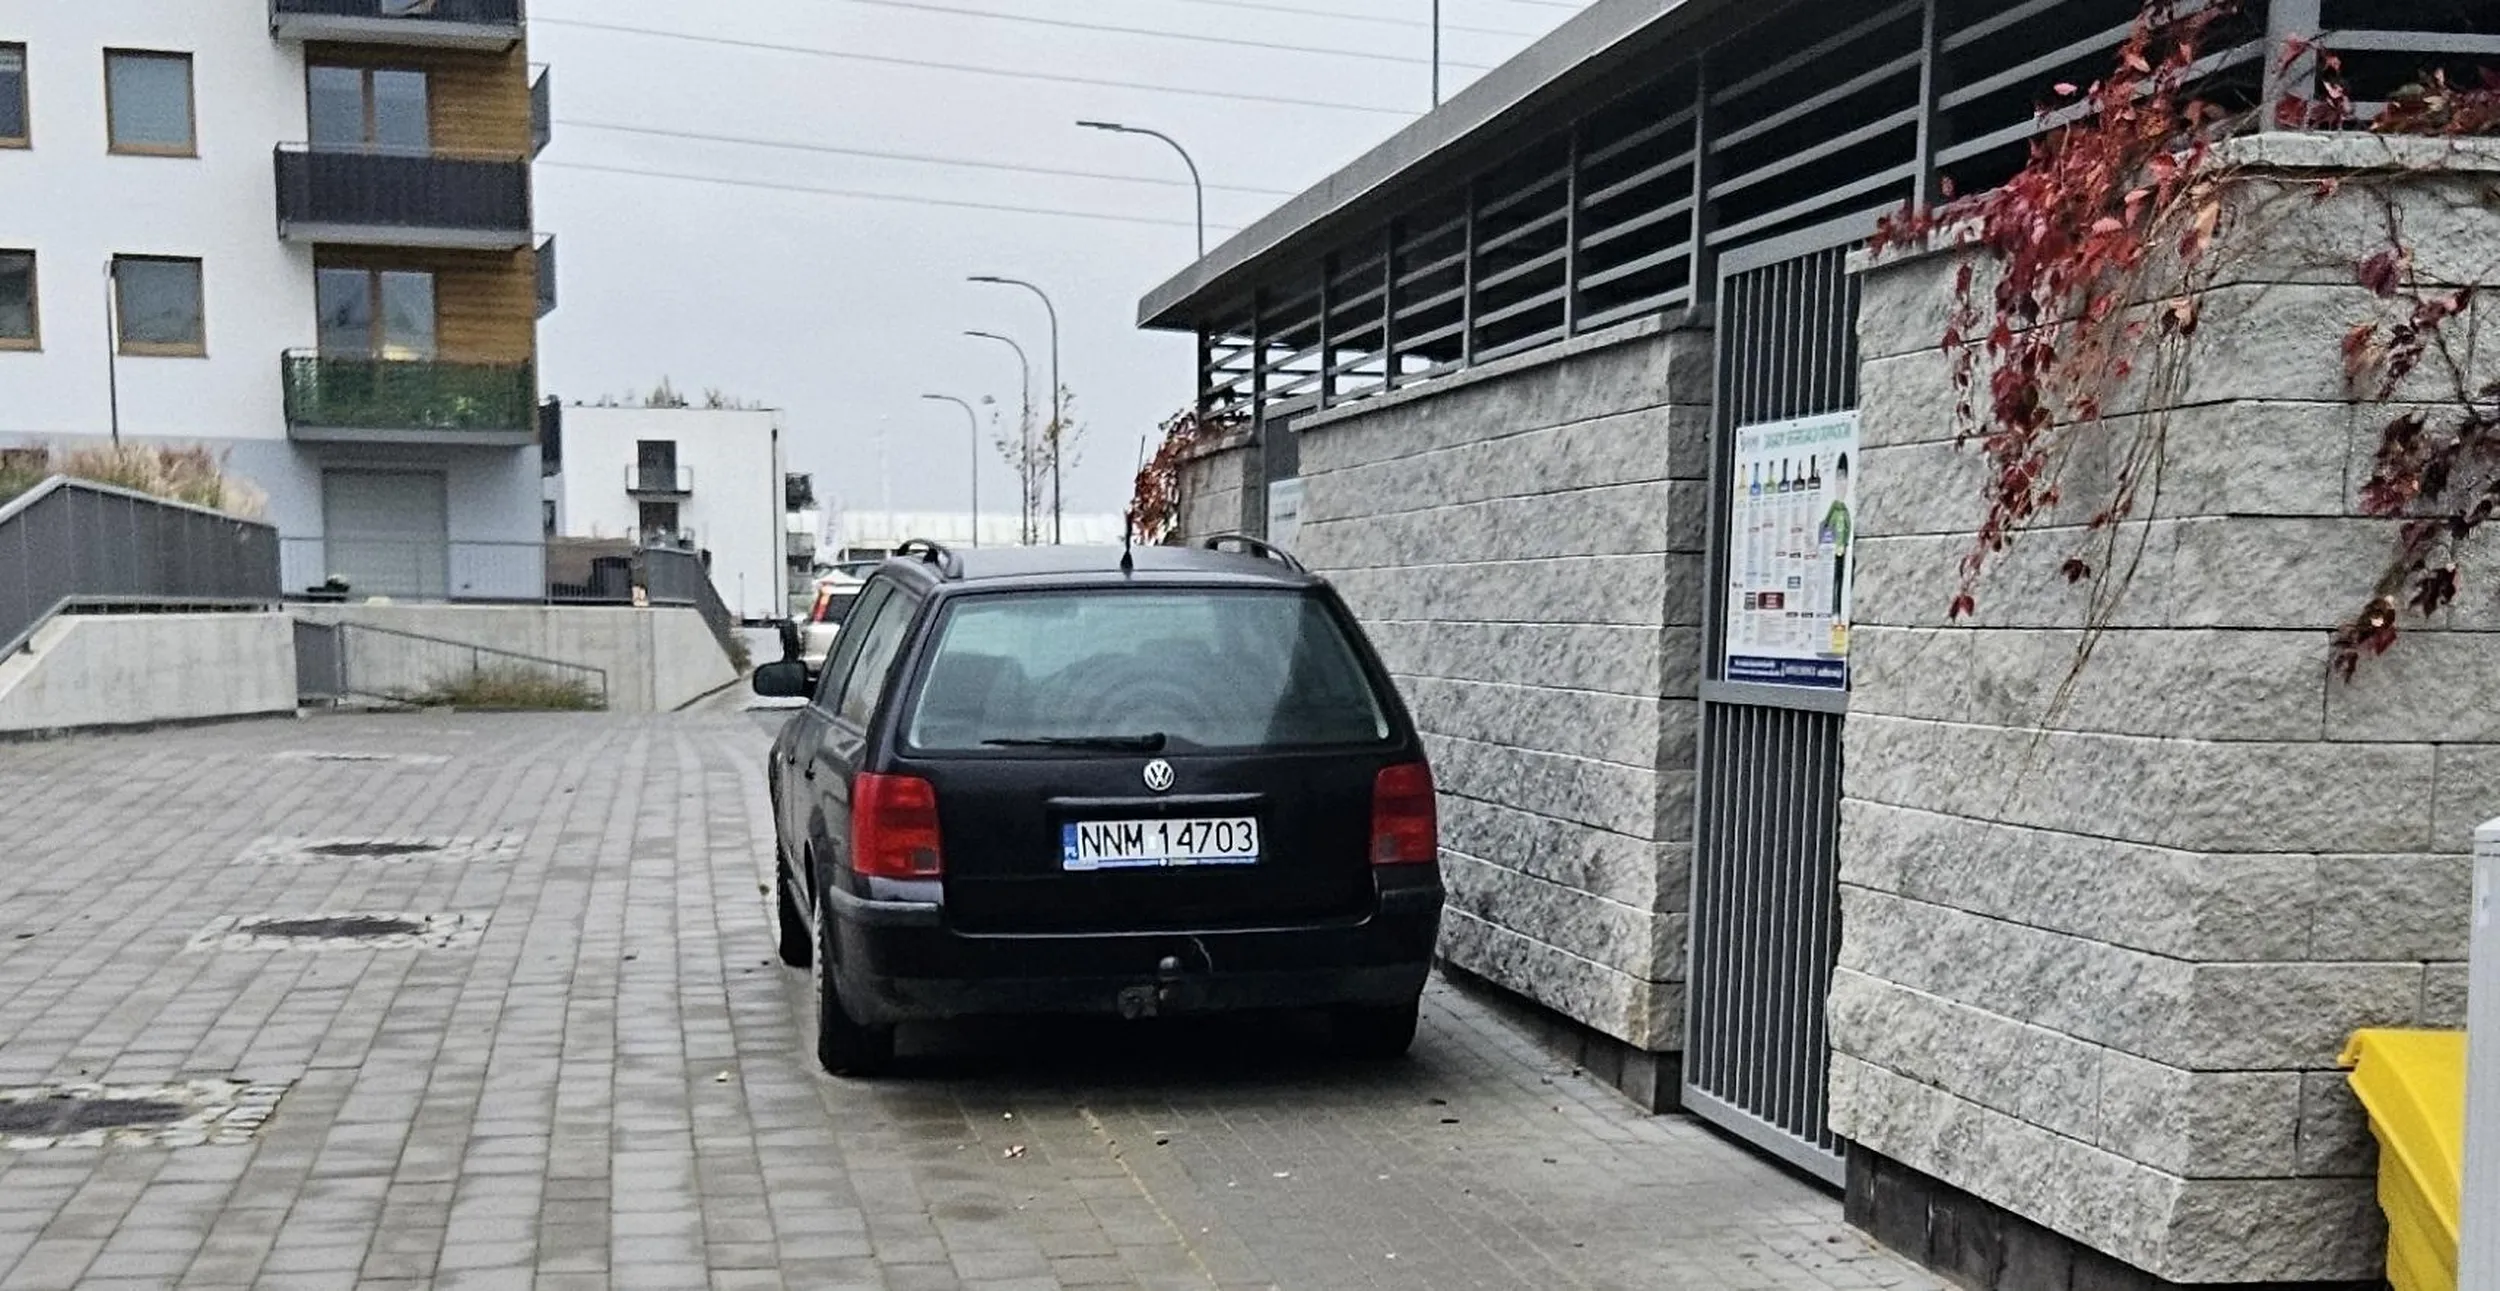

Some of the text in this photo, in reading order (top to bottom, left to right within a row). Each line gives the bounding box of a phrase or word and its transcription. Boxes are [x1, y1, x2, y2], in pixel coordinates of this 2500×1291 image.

[1143, 758, 1175, 791] VW
[1081, 824, 1144, 857] NNM
[1158, 821, 1253, 855] 14703
